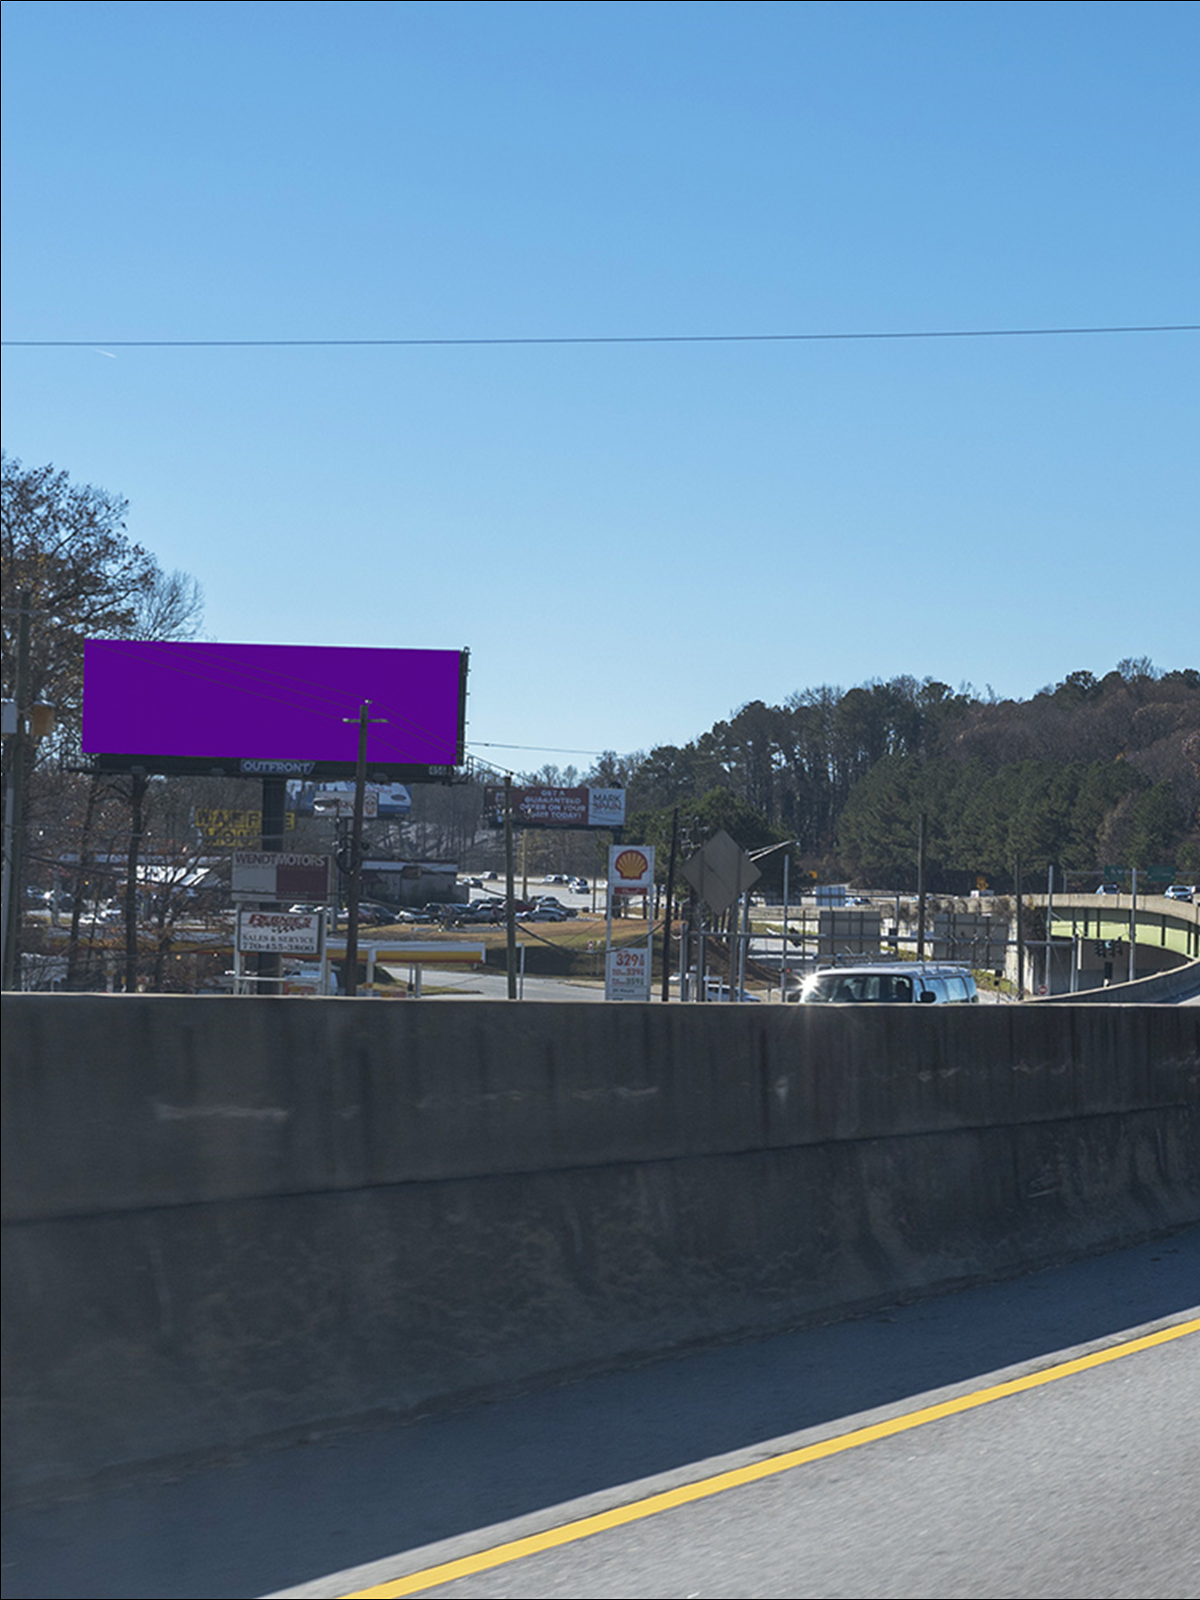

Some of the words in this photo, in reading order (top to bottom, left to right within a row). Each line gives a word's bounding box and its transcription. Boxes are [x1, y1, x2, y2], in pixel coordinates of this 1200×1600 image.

[243, 760, 312, 774] OUTFRONT
[196, 809, 293, 829] WAFFE
[235, 853, 278, 865] WENDT
[279, 854, 325, 867] MOTORS
[242, 934, 269, 942] SALES
[278, 936, 314, 944] SERVICE
[616, 953, 639, 967] 329
